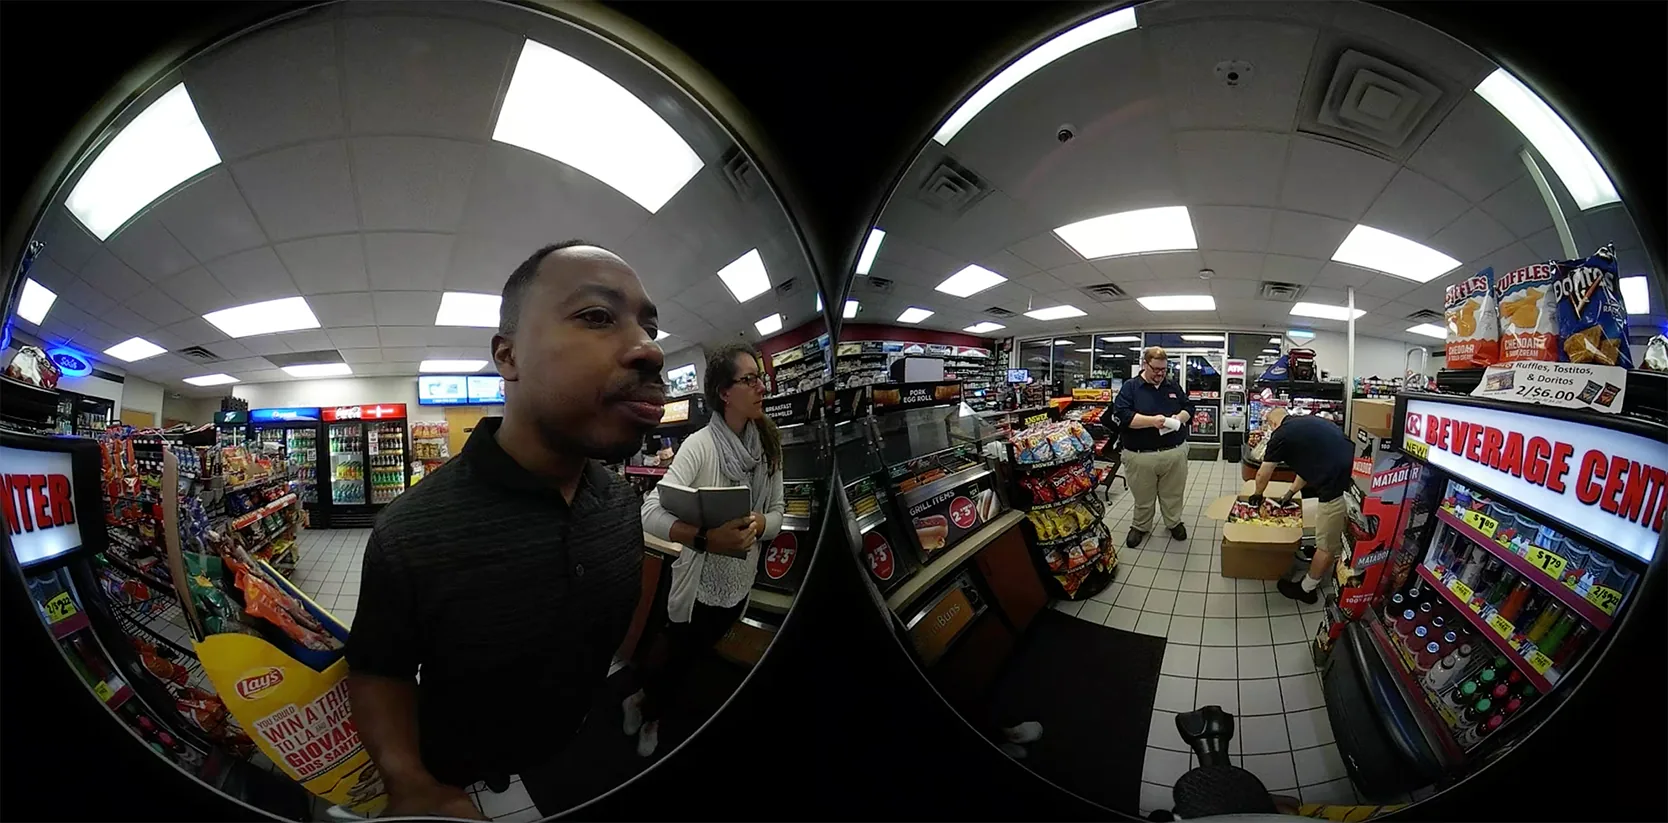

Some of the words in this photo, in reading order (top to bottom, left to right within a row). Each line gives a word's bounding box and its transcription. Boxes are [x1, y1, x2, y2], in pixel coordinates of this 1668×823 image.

[1227, 364, 1244, 373] ATM
[1516, 362, 1550, 372] Ruffles,
[1554, 364, 1594, 376] Tostitos,
[1526, 373, 1535, 381] &
[1537, 374, 1574, 386] Doritos
[903, 395, 916, 404] EGG
[917, 394, 933, 402] ROLL
[909, 388, 926, 396] PORK
[1516, 385, 1575, 401] 2/$6.00
[765, 402, 792, 412] BREAKFAST
[1406, 441, 1428, 459] NEW!
[1425, 414, 1574, 494] BEVERAGE
[1372, 466, 1419, 488] MATADOR
[909, 501, 932, 516] GRILL
[932, 489, 956, 506] ITEMS
[257, 718, 271, 729] YOU
[273, 706, 295, 724] COULD
[262, 714, 303, 744] WIN
[305, 707, 318, 725] A
[275, 741, 295, 755] TO
[296, 759, 324, 776] DOS
